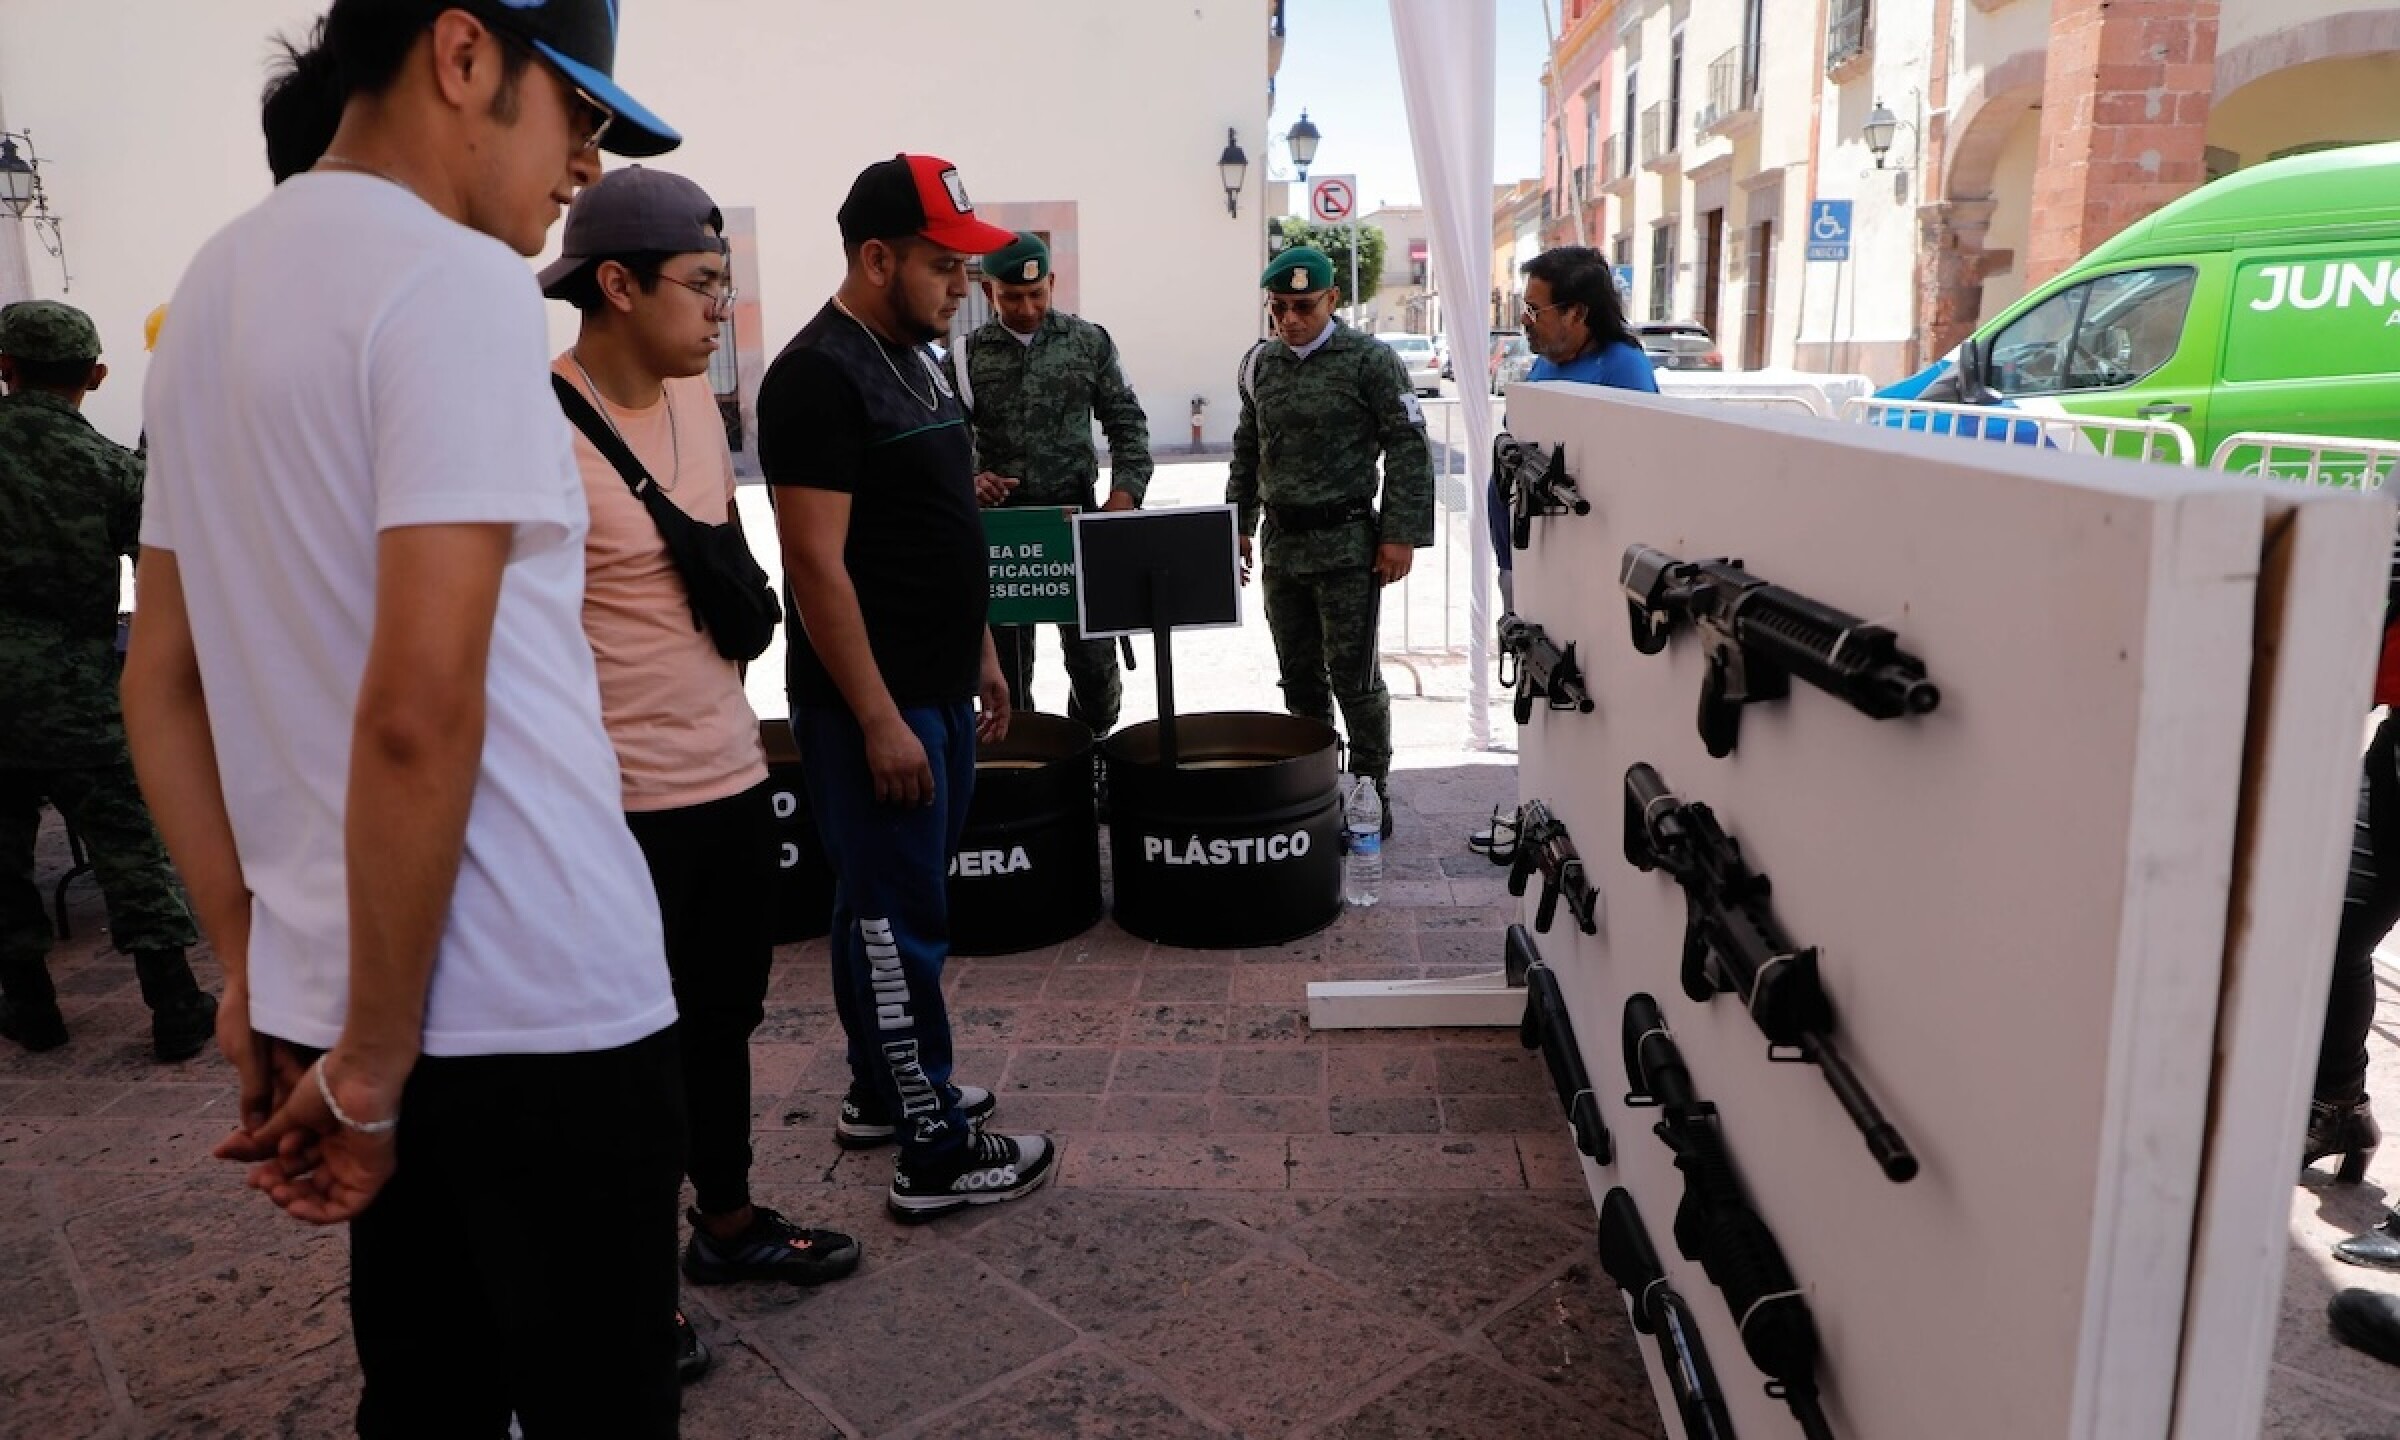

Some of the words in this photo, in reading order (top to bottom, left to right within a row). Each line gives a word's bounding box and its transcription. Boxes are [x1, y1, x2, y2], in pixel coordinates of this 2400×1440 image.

[1019, 543, 1043, 559] DE
[1143, 829, 1312, 866] PLÁSTICO
[860, 917, 915, 1030] PUMA
